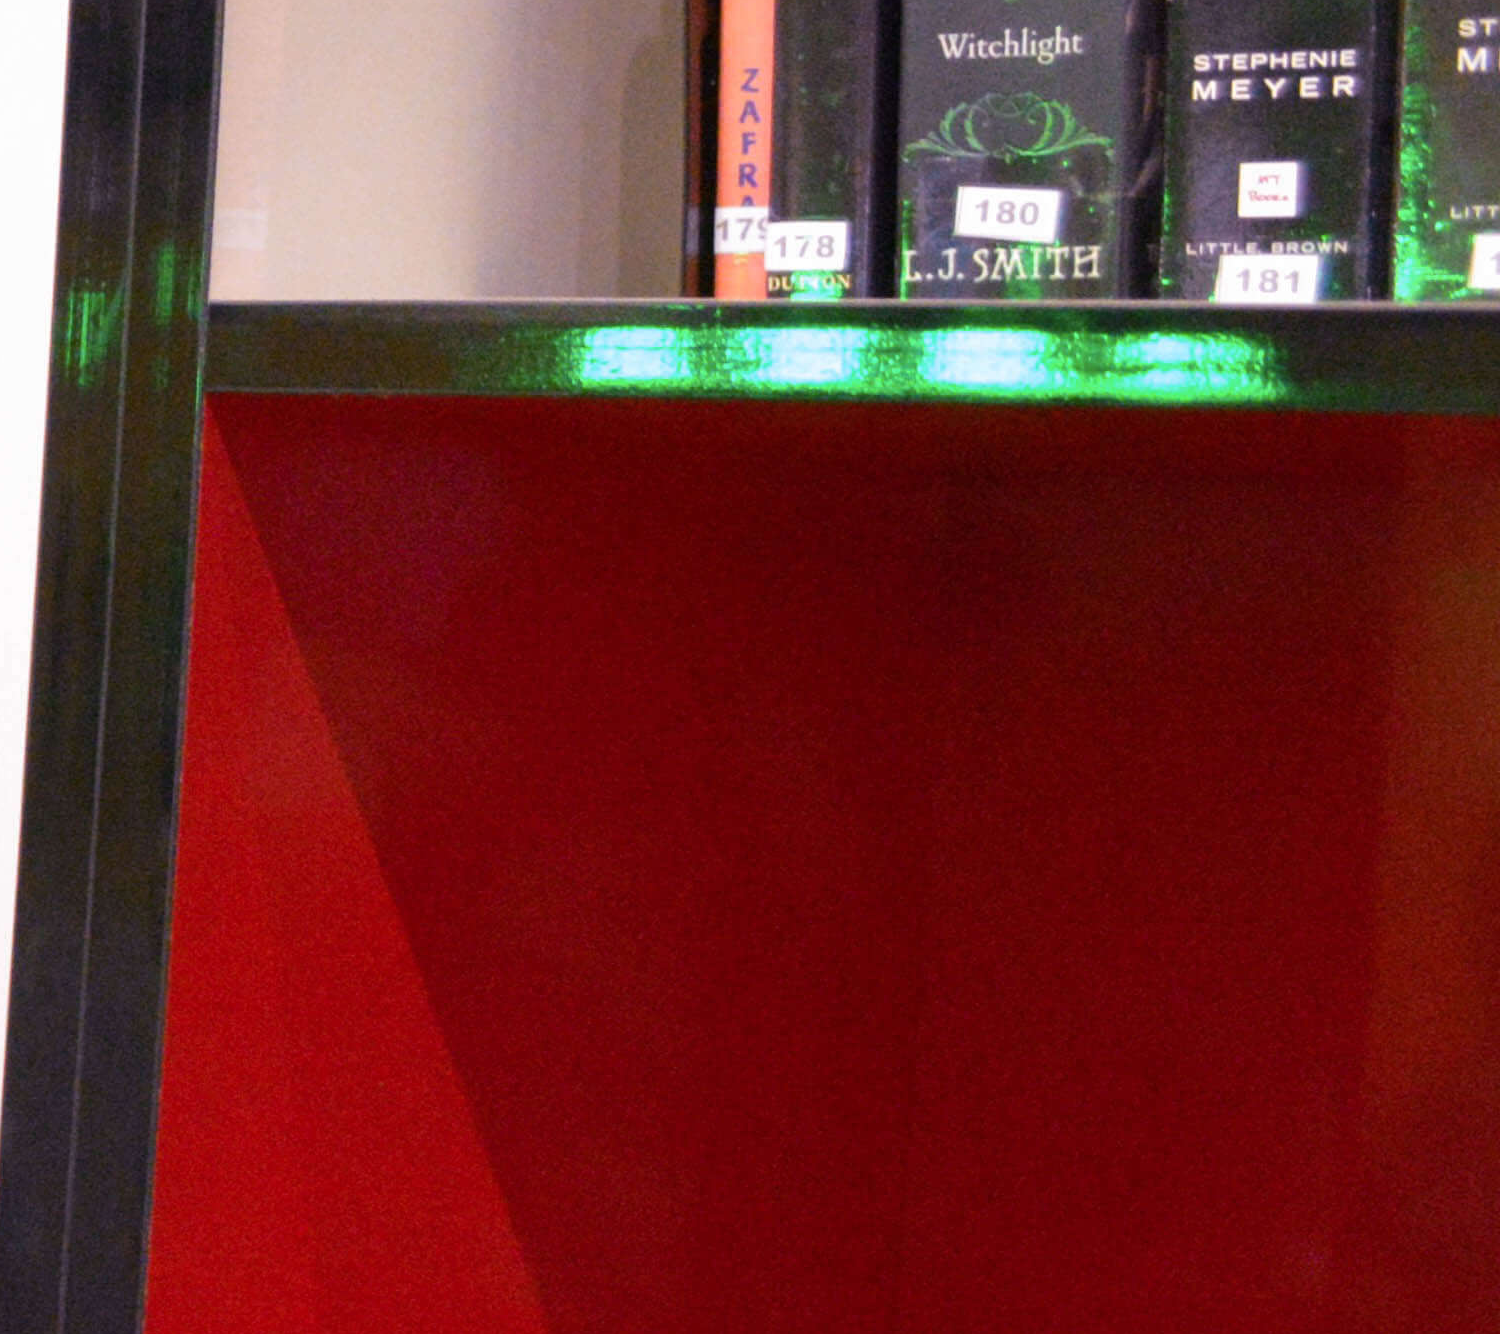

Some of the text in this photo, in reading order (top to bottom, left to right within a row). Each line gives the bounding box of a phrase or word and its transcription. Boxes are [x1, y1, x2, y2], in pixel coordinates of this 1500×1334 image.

[937, 27, 1084, 63] Witchlight
[1193, 48, 1357, 72] STEPHENIE
[1191, 76, 1356, 102] MEYER
[975, 197, 1040, 227] 180
[774, 234, 835, 258] 178
[1270, 240, 1349, 255] BROWN
[974, 244, 1101, 282] SMITH
[1236, 268, 1300, 294] 181
